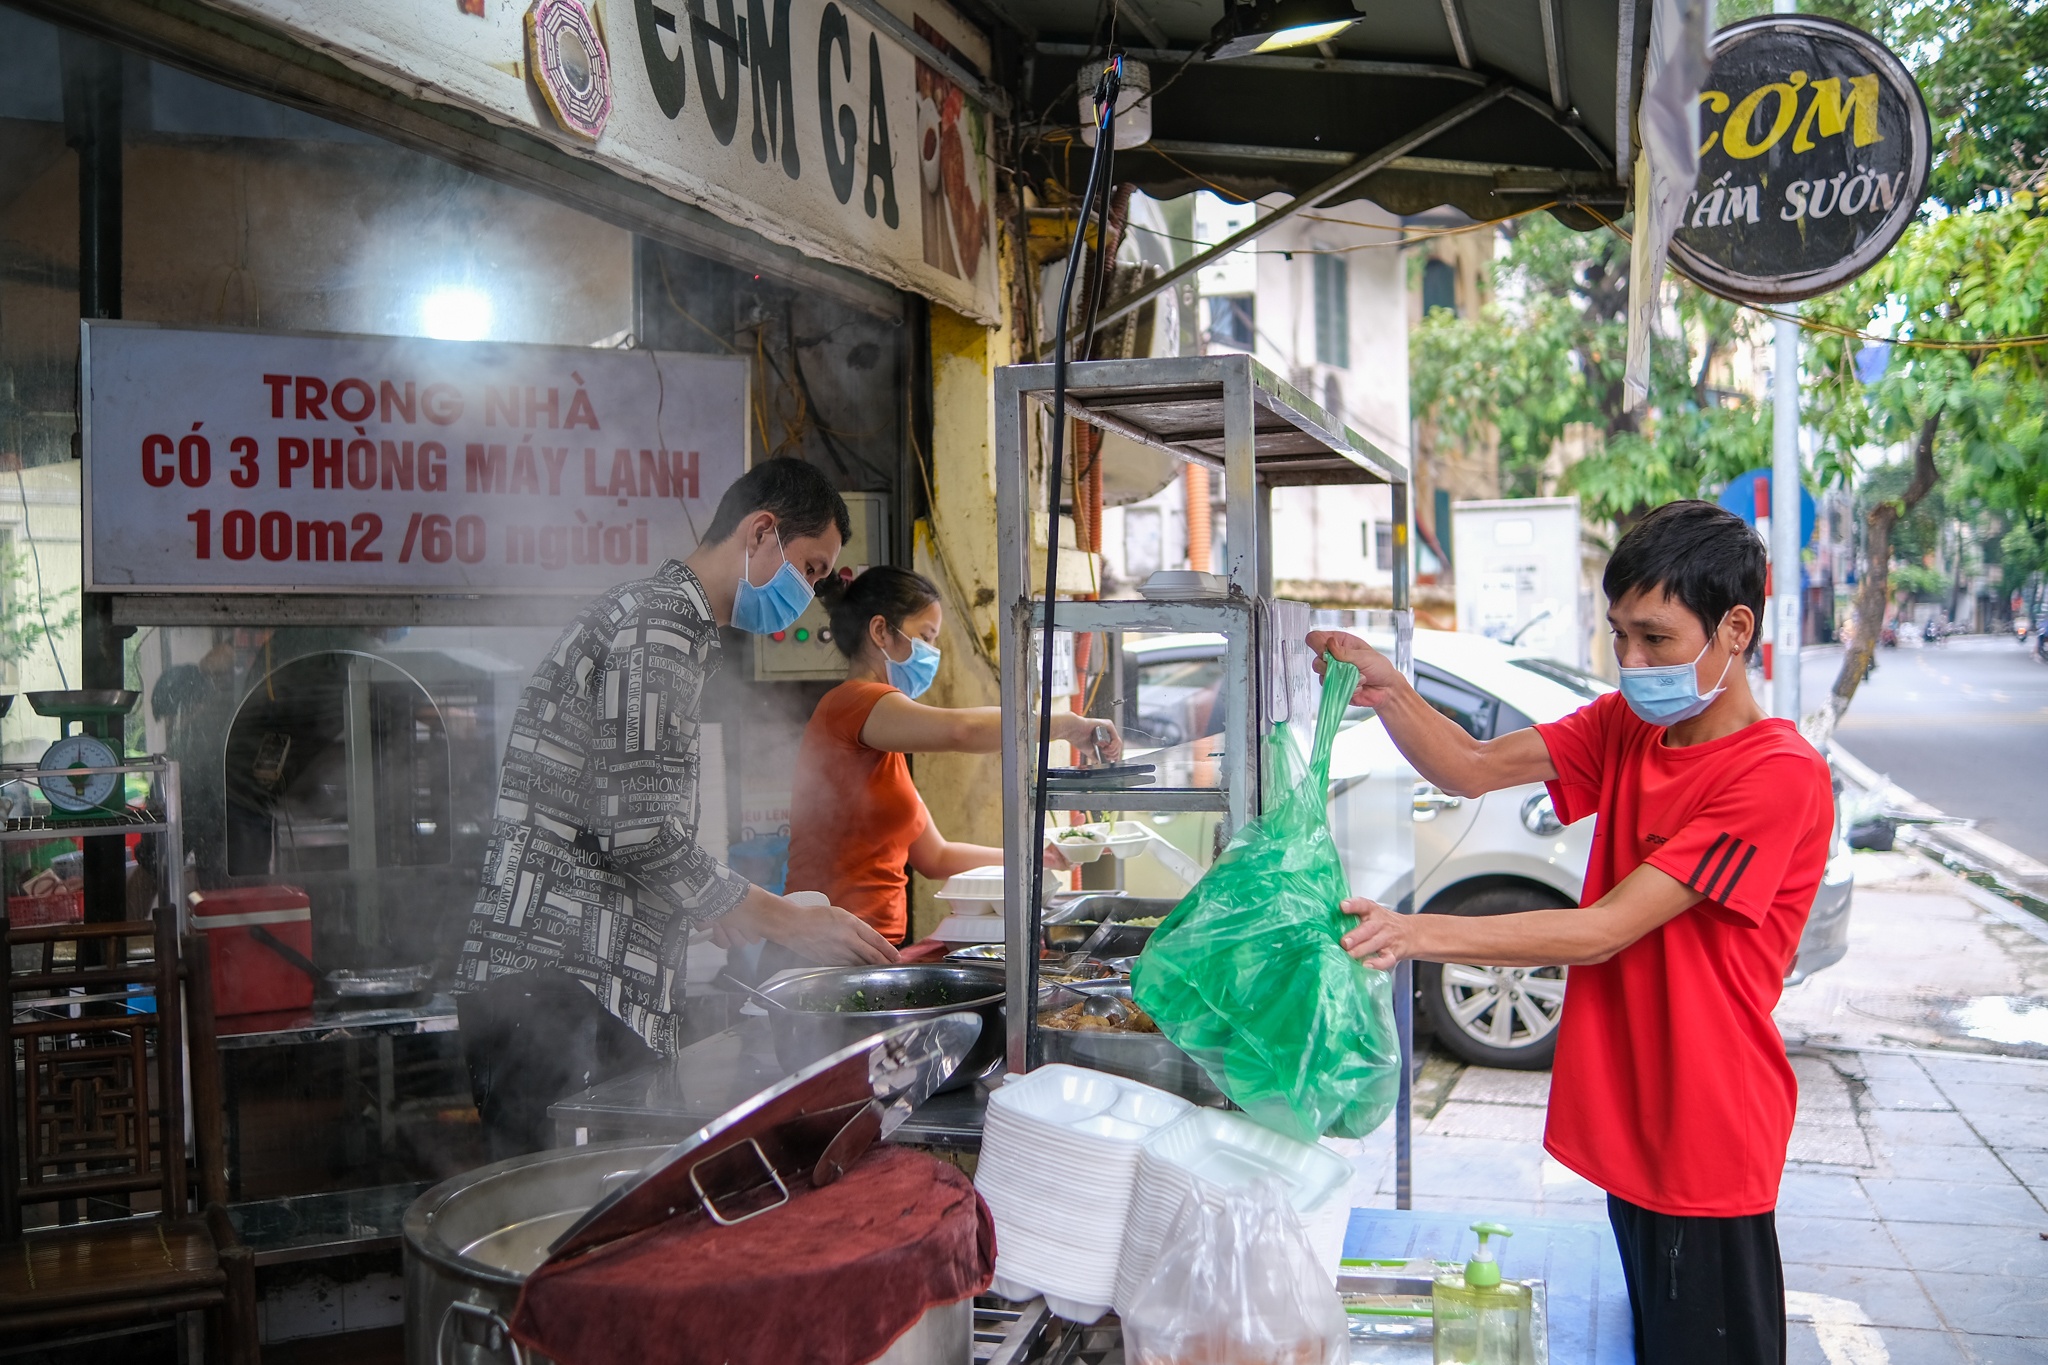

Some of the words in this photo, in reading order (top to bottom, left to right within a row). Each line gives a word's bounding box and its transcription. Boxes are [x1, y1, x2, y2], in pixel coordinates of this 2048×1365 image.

[263, 373, 465, 427] TRONG
[484, 369, 601, 431] NHÀ
[142, 421, 212, 489] CÓ
[230, 436, 260, 489] 3
[278, 426, 448, 493] PHÒNG
[465, 433, 569, 496] MÁY
[584, 448, 699, 507] LẠNH
[187, 508, 383, 562] 100m2
